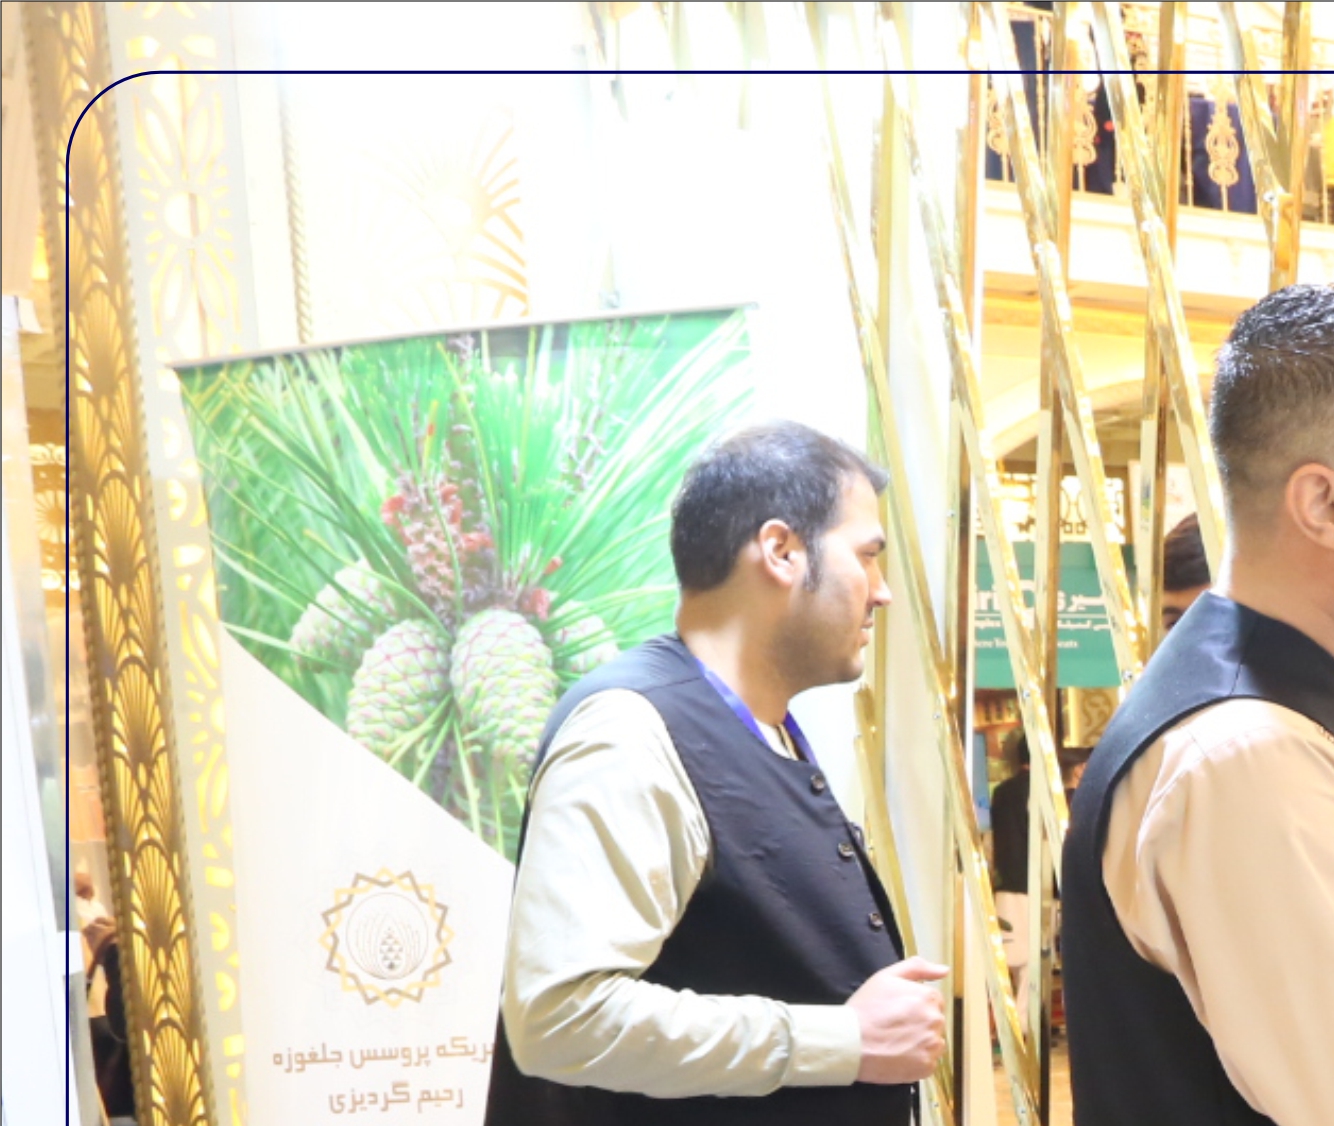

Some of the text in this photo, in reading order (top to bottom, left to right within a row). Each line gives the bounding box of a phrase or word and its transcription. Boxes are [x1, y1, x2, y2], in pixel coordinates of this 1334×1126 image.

[272, 1042, 343, 1074] جلغوزه
[349, 1044, 431, 1070] پروسس
[328, 1081, 464, 1115] رحیم گردیزی
